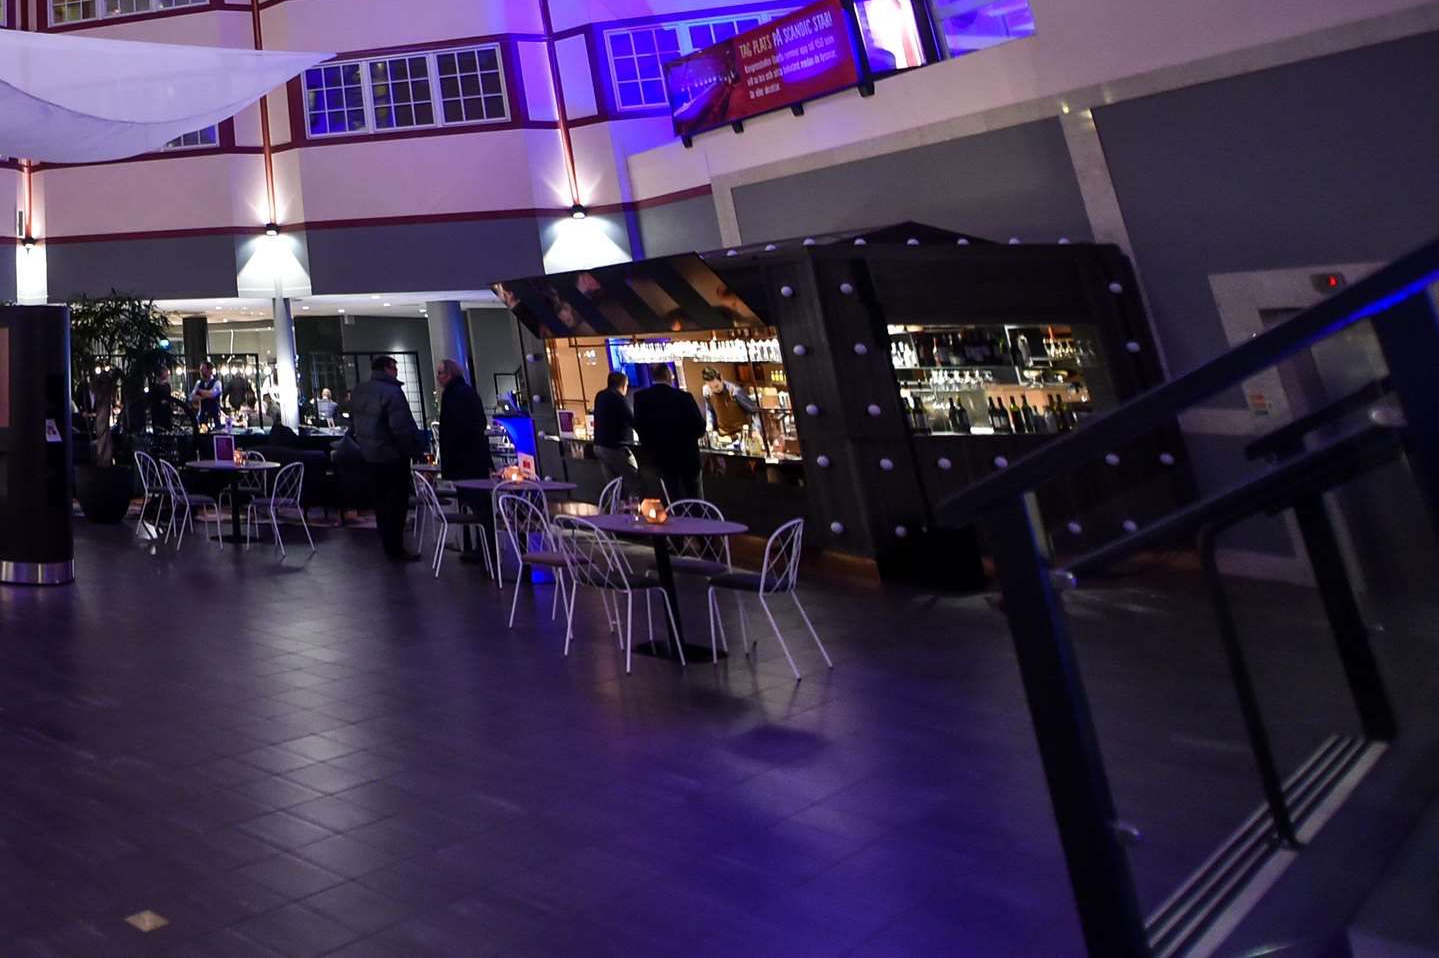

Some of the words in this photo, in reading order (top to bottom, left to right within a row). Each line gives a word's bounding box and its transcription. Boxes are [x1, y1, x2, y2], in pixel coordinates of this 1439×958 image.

[739, 42, 752, 58] TAG
[752, 34, 772, 55] PLATS
[772, 27, 783, 49] PÅ
[782, 19, 813, 43] SCANDIC
